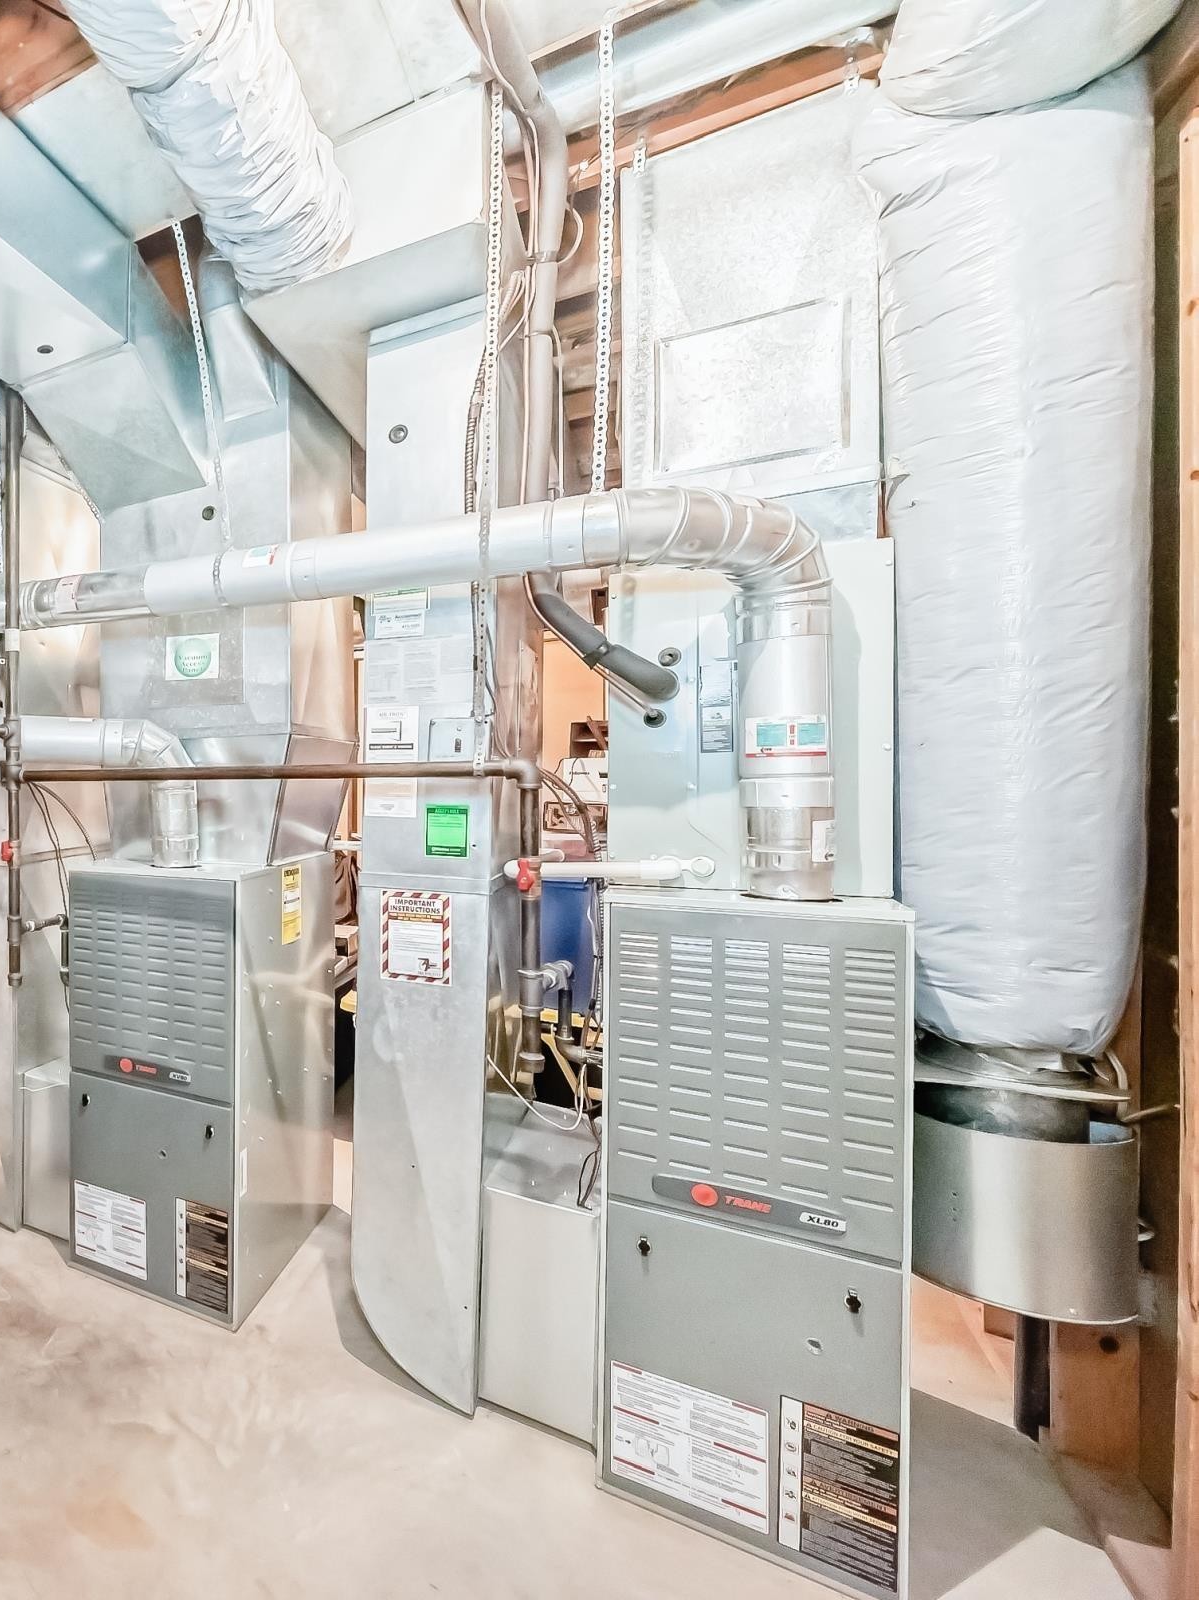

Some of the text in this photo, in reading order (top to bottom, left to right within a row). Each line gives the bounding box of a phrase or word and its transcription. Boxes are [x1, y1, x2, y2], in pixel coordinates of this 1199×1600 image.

[394, 898, 436, 907] IMPORTANT
[390, 905, 441, 914] INSTRUCTIONS
[724, 1196, 839, 1228] TRANE XL80
